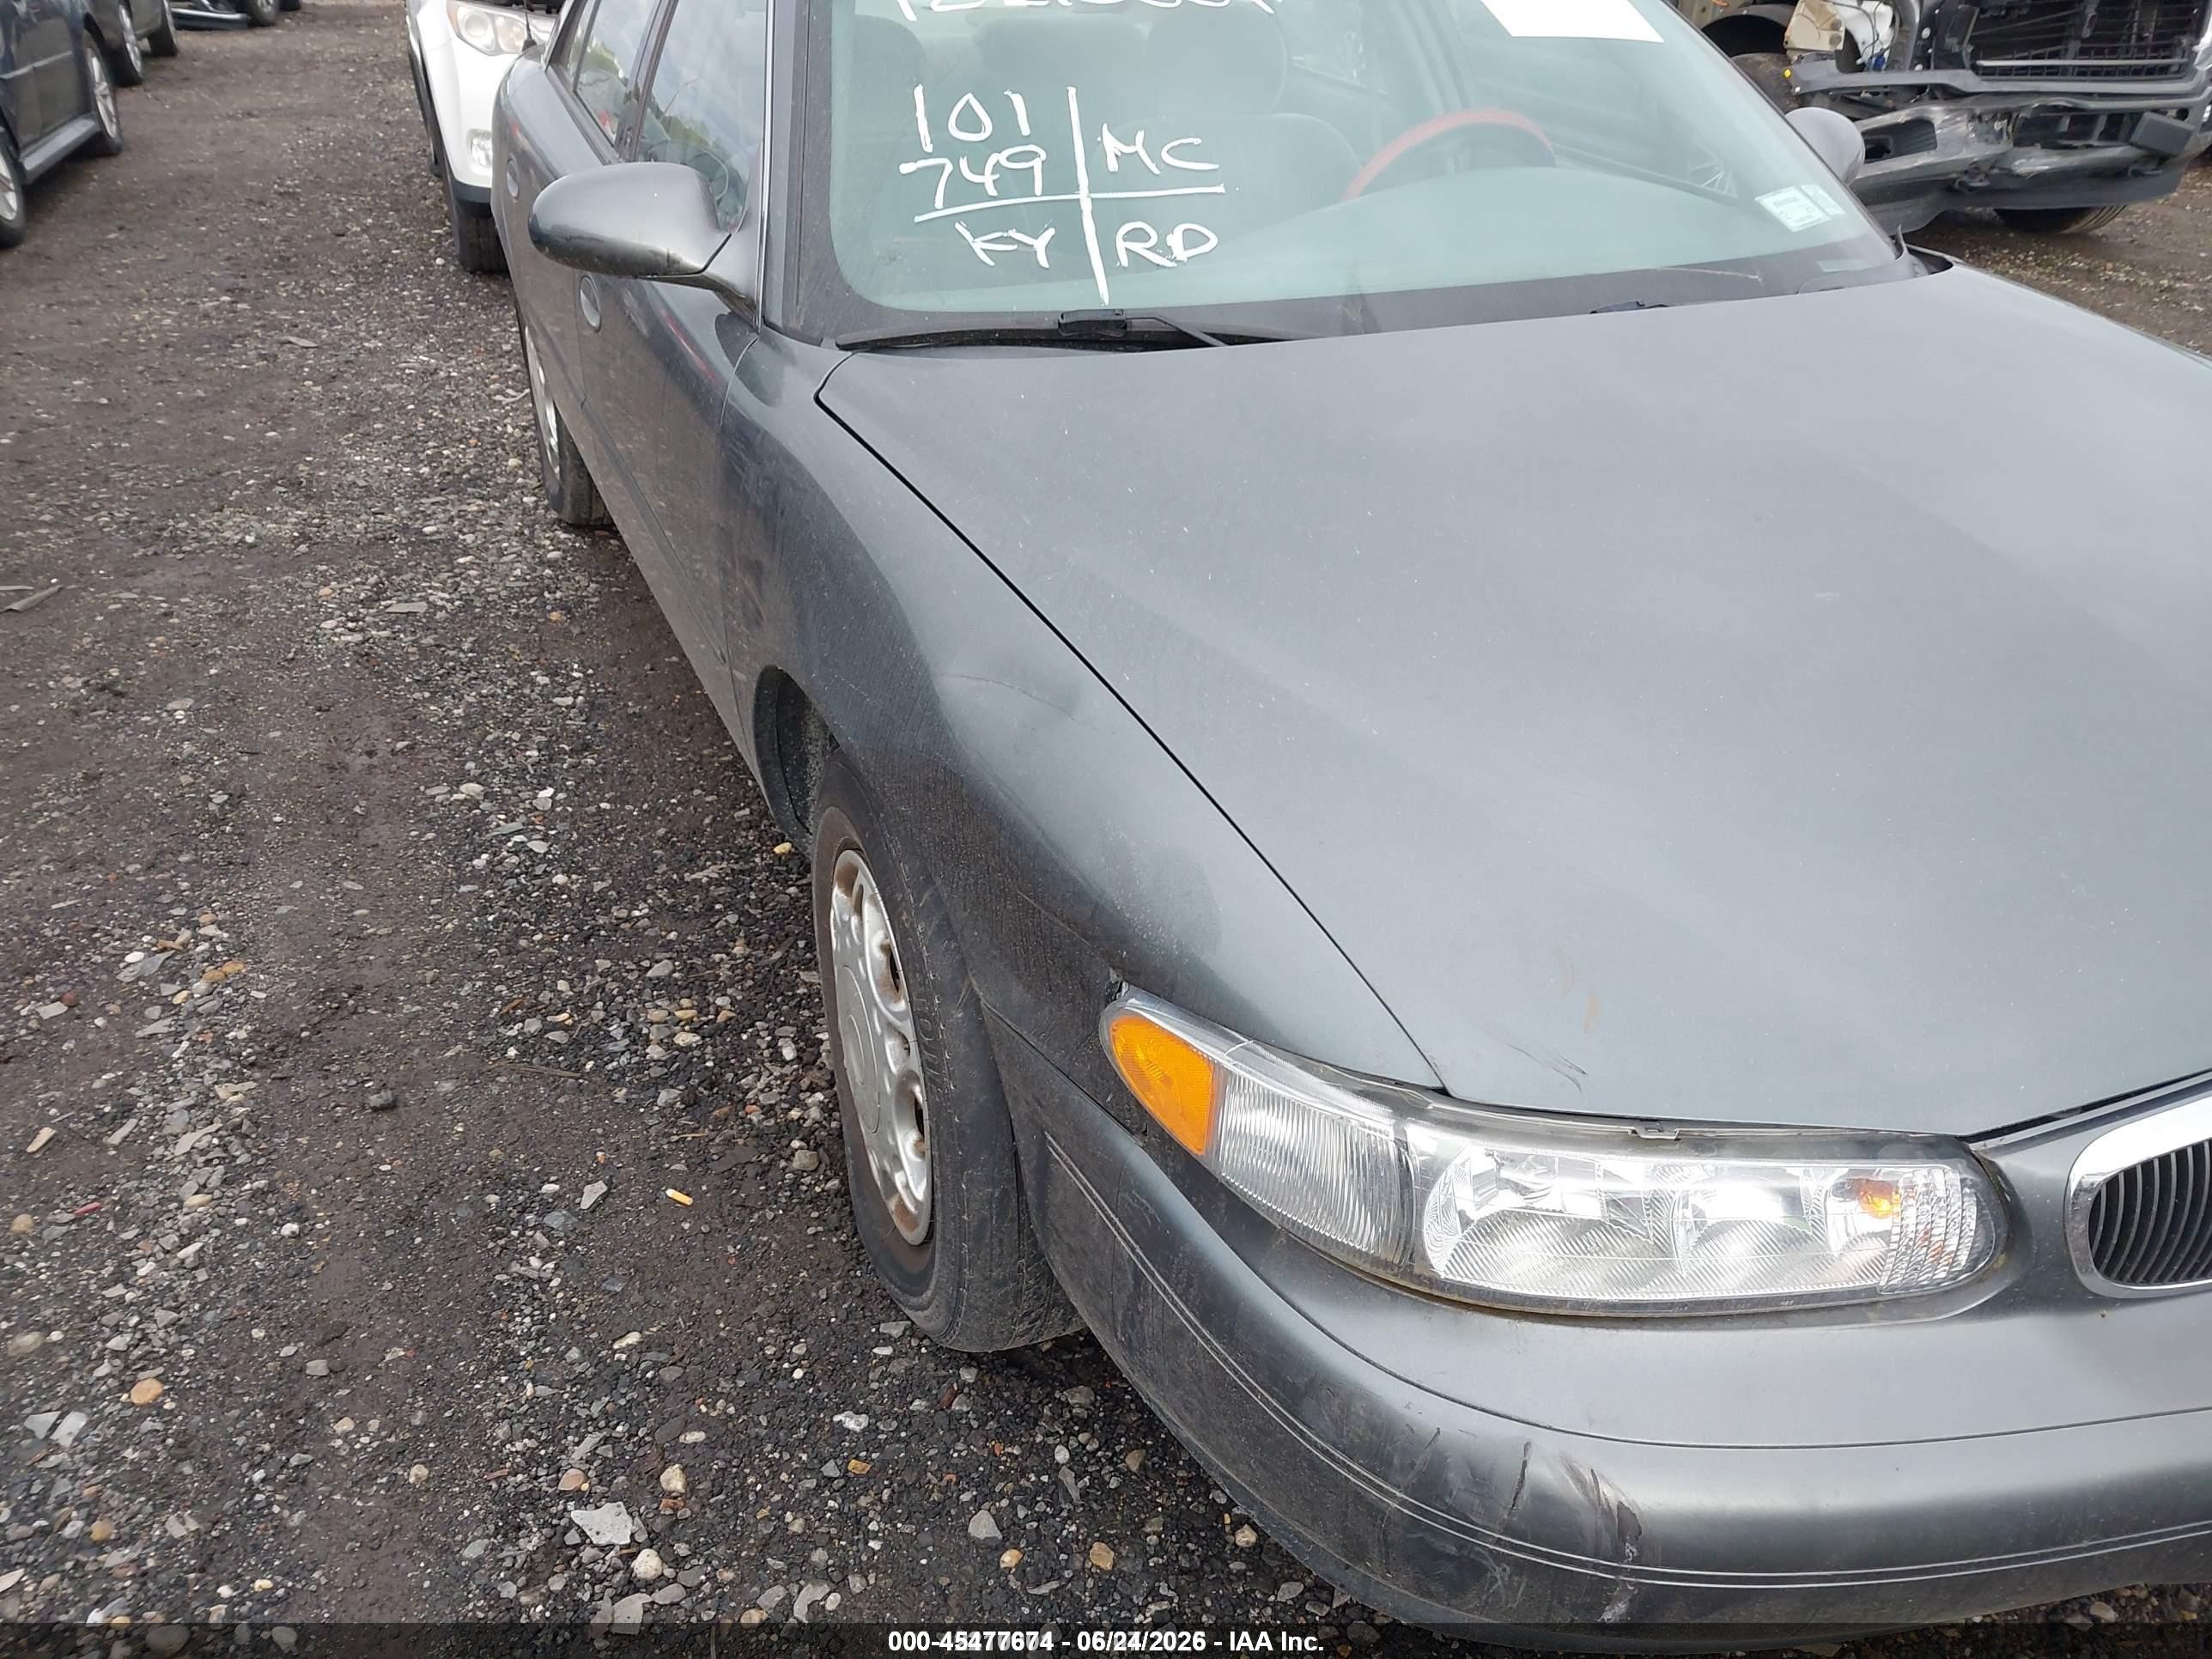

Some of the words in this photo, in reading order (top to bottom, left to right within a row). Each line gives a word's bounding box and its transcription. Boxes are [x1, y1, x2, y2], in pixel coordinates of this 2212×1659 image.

[914, 83, 1031, 153] 101
[1097, 123, 1220, 175] MC
[898, 144, 1047, 210] 749
[954, 221, 1056, 269] KY
[1115, 221, 1218, 268] RD
